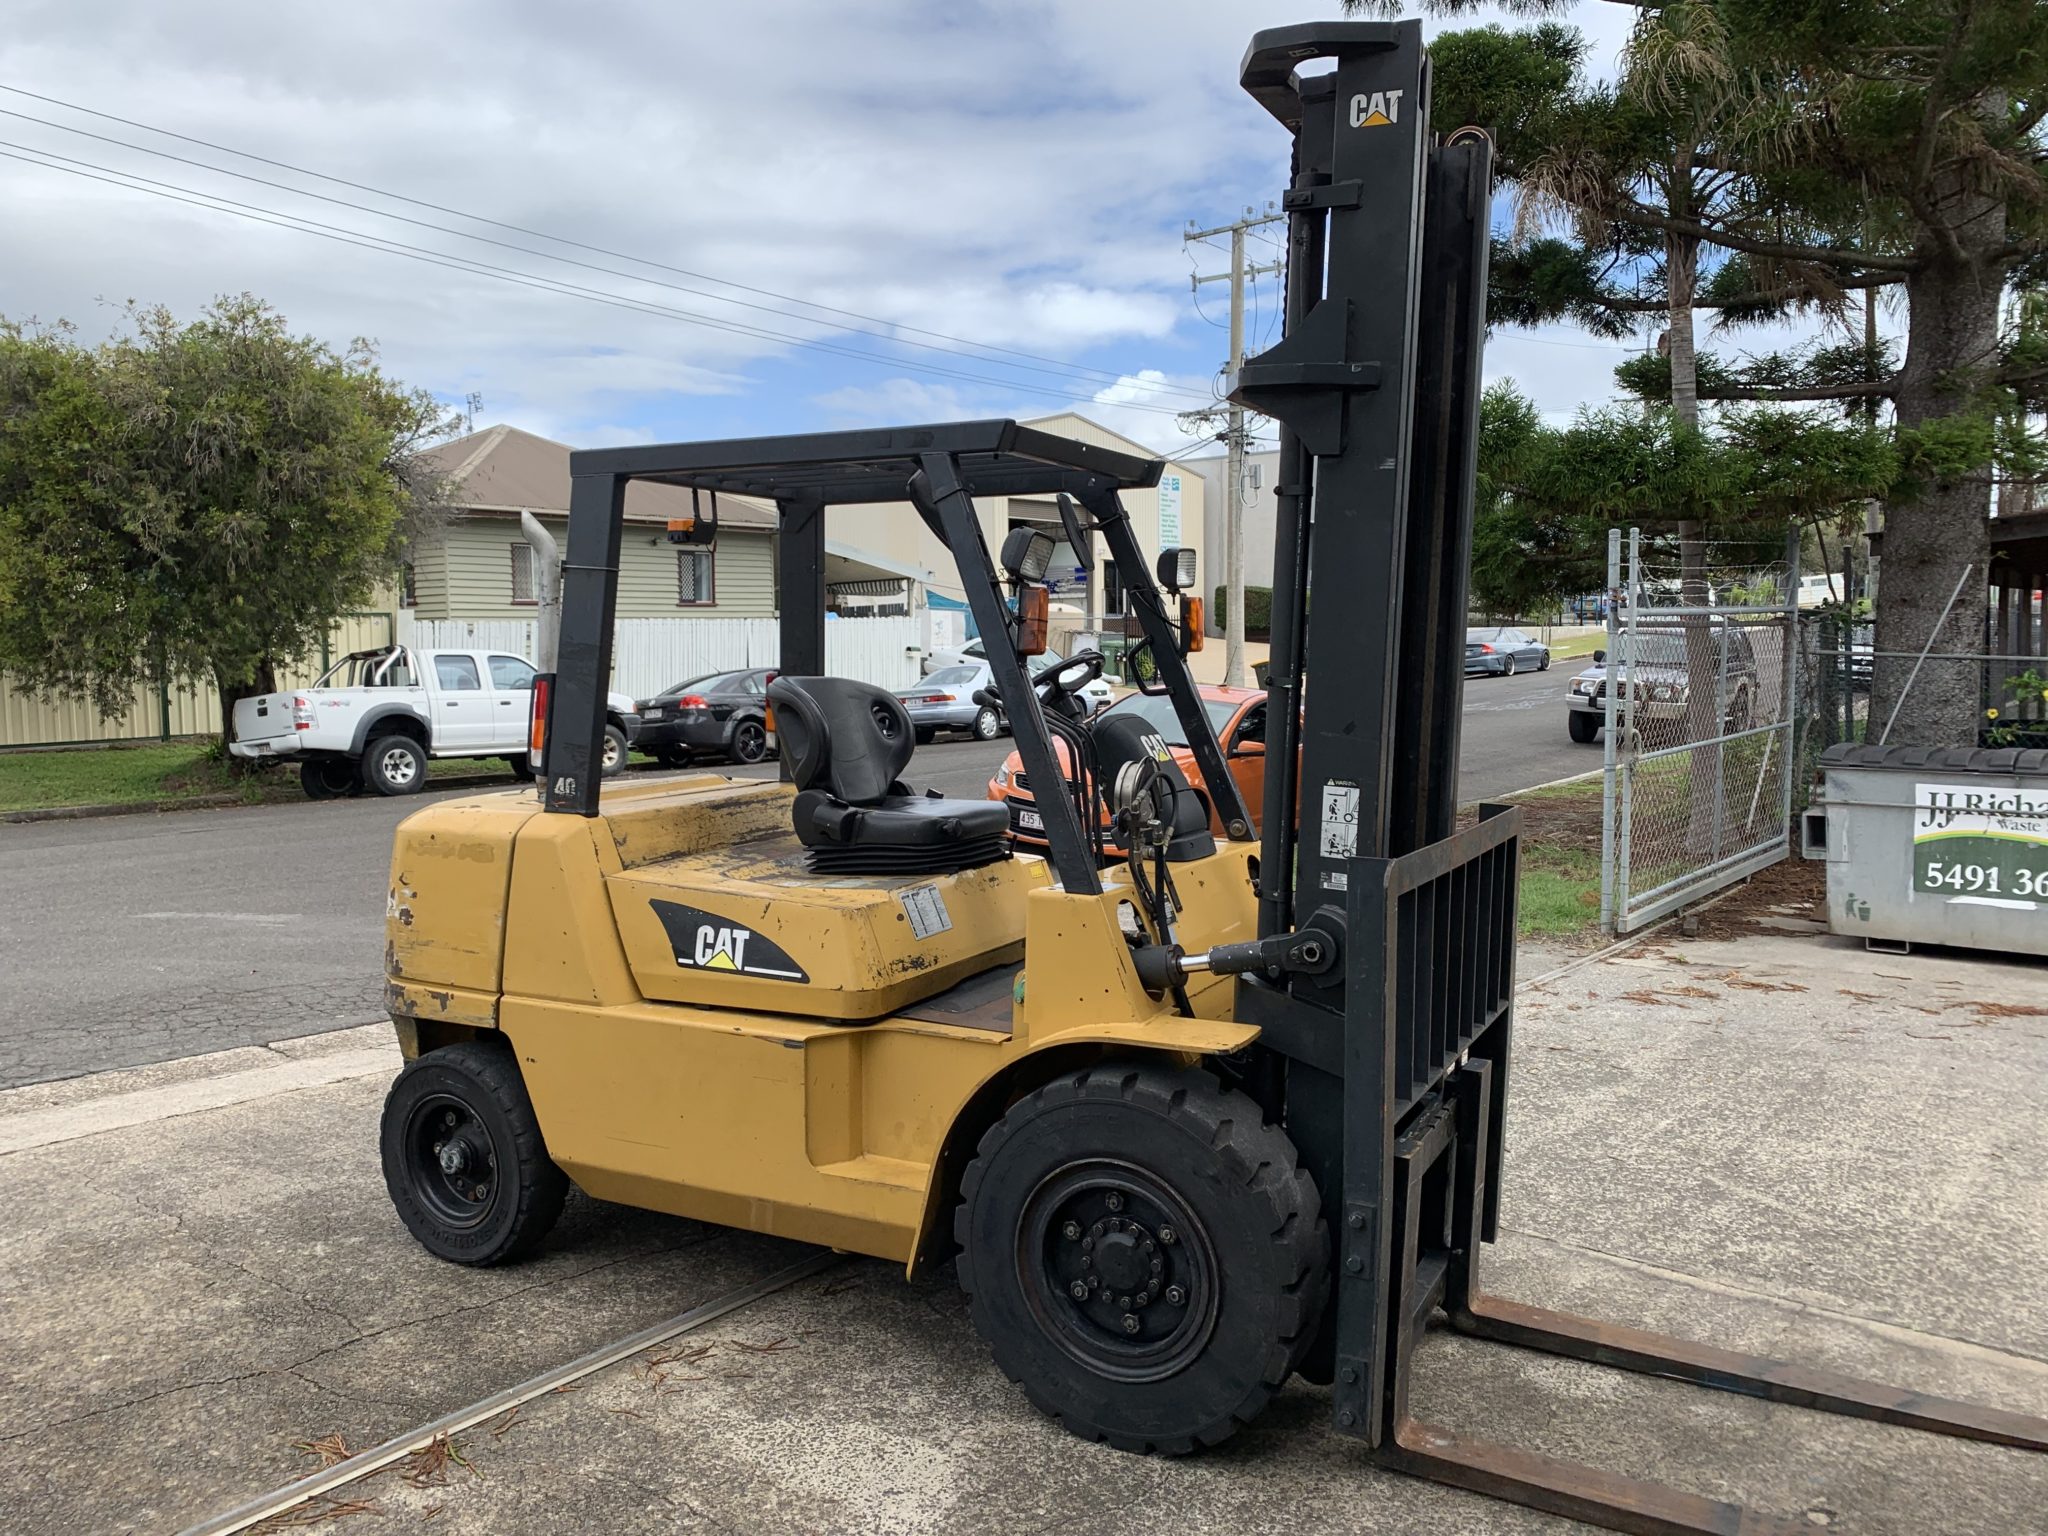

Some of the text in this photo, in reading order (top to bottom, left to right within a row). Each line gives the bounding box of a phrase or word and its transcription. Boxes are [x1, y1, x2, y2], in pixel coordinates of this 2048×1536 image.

[1350, 89, 1403, 128] CAT
[1140, 733, 1174, 763] CAT
[1924, 862, 2002, 893] 5491
[694, 924, 750, 971] CAT
